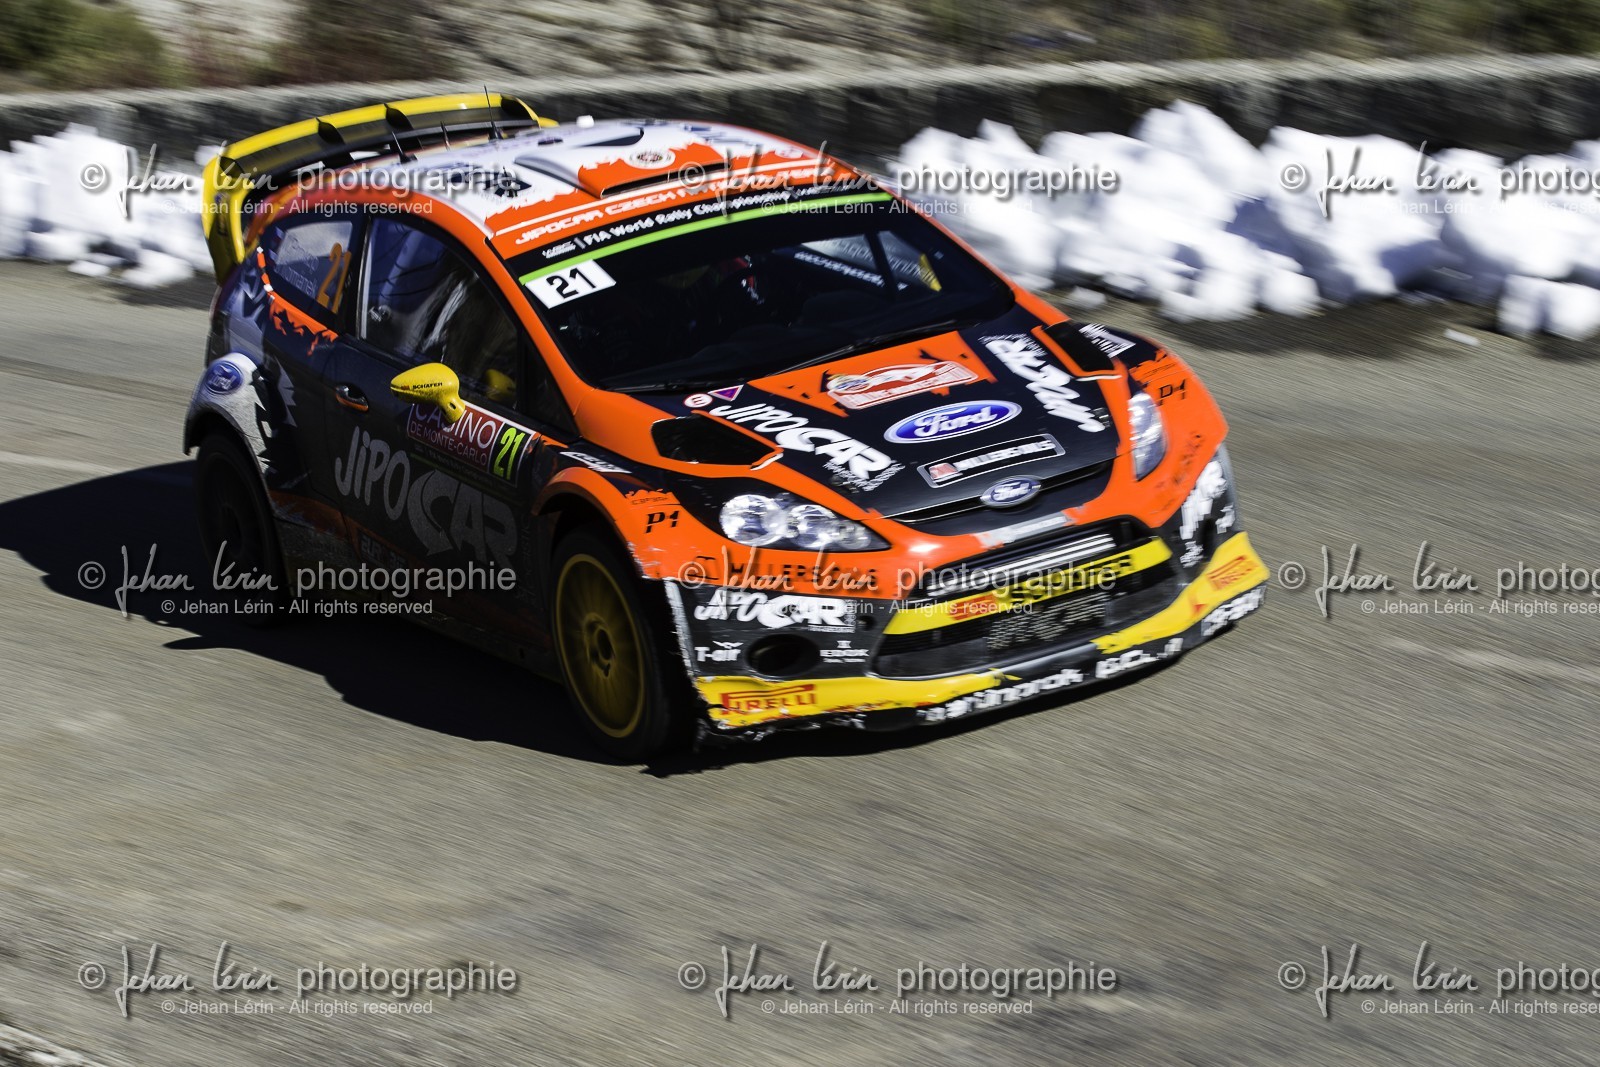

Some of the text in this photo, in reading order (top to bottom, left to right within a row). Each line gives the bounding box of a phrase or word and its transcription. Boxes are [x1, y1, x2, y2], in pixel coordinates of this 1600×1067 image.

[515, 209, 604, 245] JIPOCAR
[610, 217, 654, 237] World
[655, 207, 692, 227] Rally
[546, 268, 597, 299] 21
[415, 404, 497, 449] CAINO
[913, 406, 998, 438] Ford
[410, 420, 488, 466] DE MONTE-CARLO
[493, 427, 526, 481] 21
[645, 510, 679, 534] P1
[720, 684, 817, 716] PIRELLI
